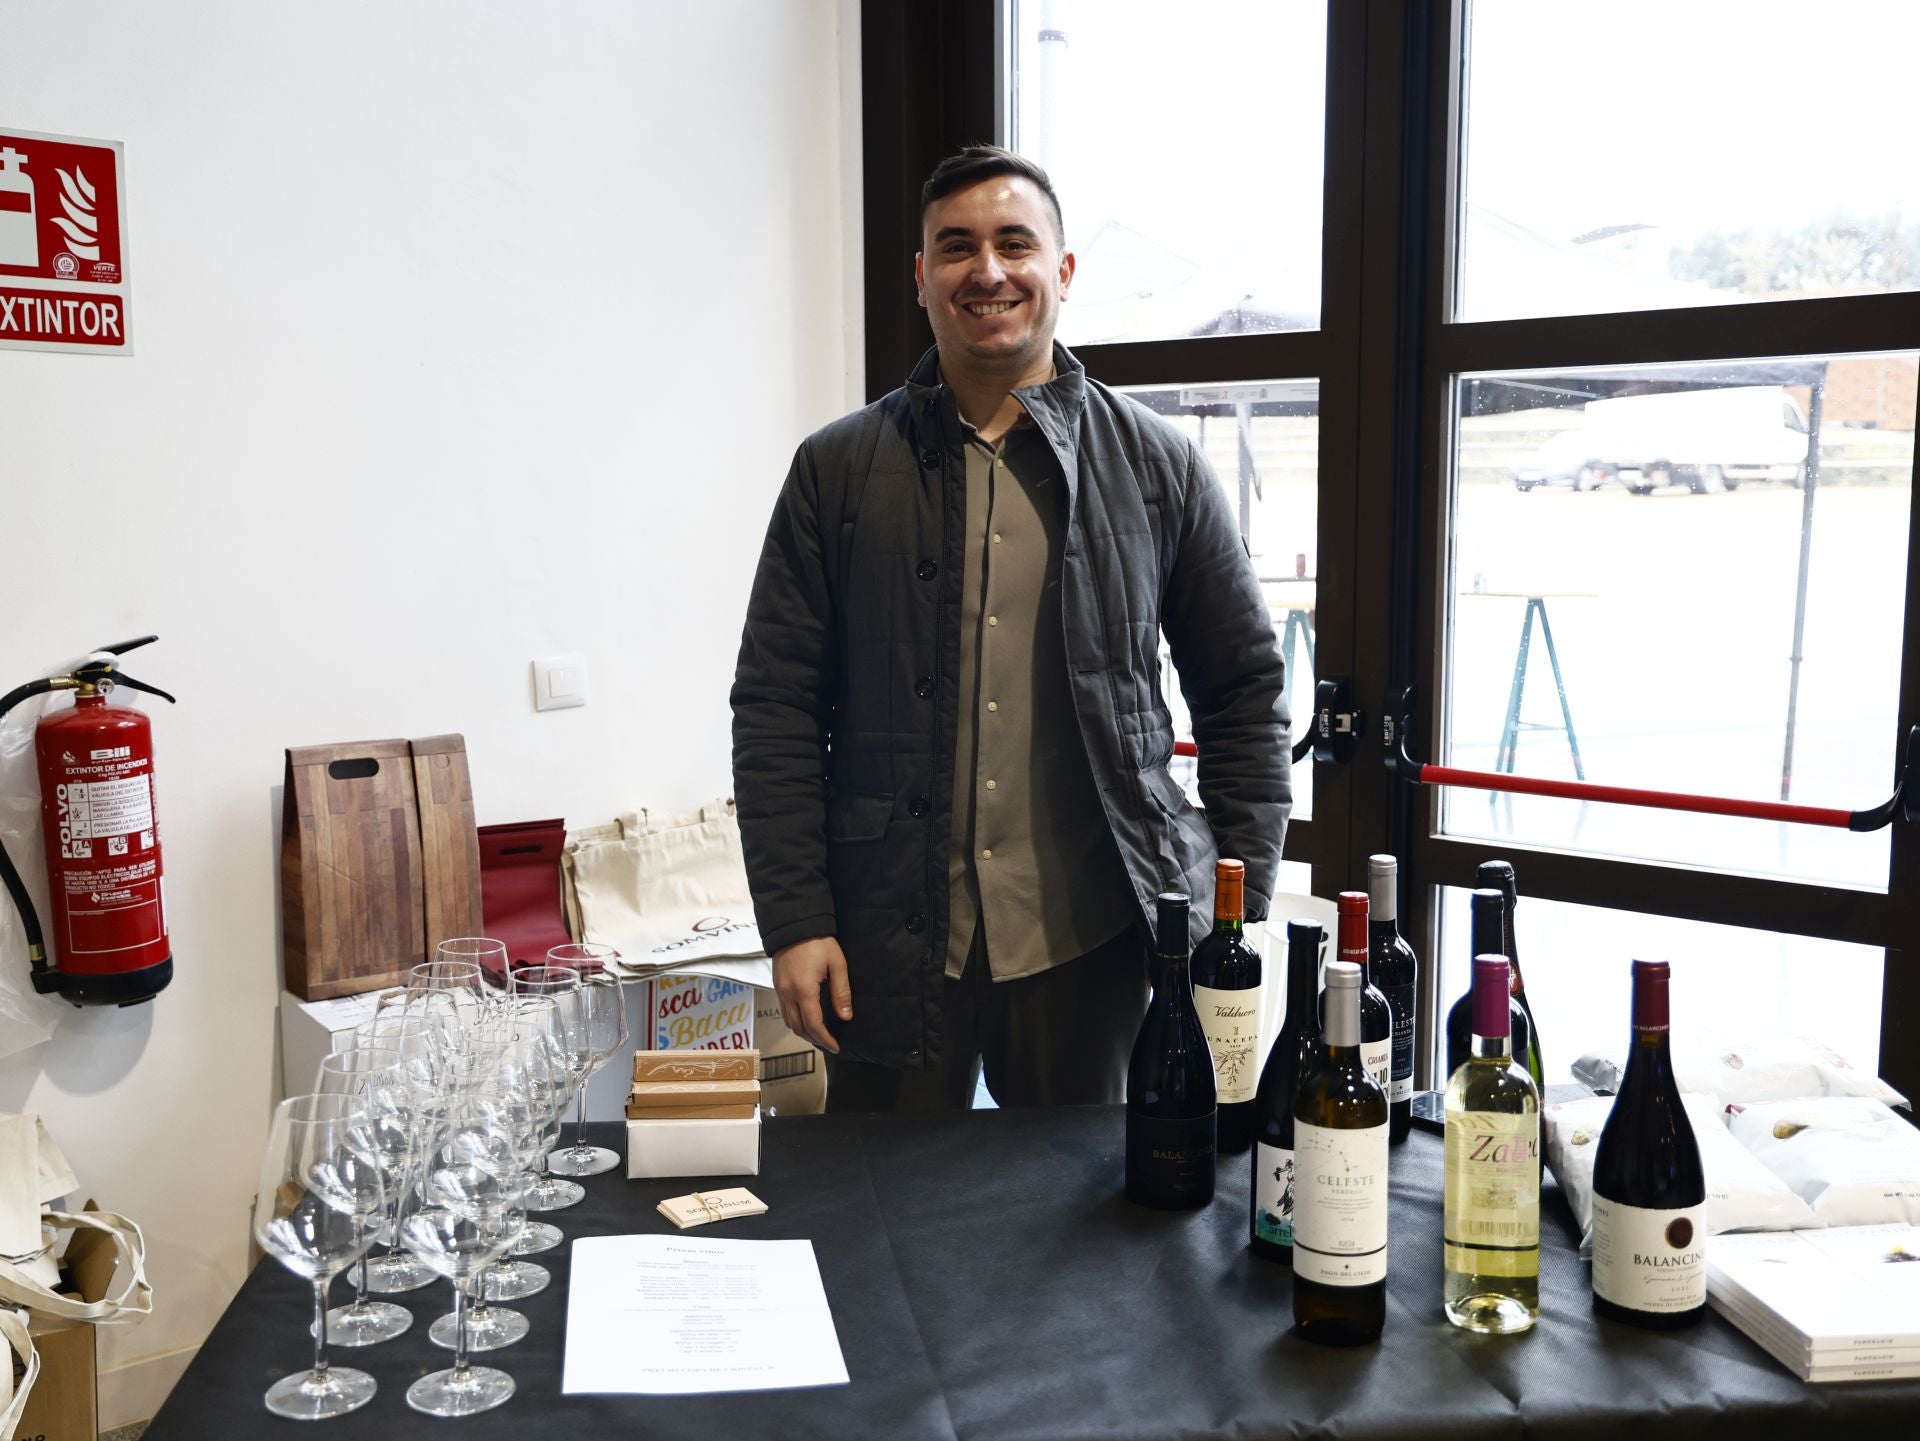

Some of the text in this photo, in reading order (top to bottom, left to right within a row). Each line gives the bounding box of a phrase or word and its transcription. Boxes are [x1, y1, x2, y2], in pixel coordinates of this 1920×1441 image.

[0, 296, 121, 338] XTINTOR
[66, 766, 104, 775] EXTINTOR
[104, 764, 116, 772] DE
[56, 784, 74, 858] POLVO
[1214, 1006, 1256, 1018] Valduero
[1317, 1174, 1376, 1187] CELESTE
